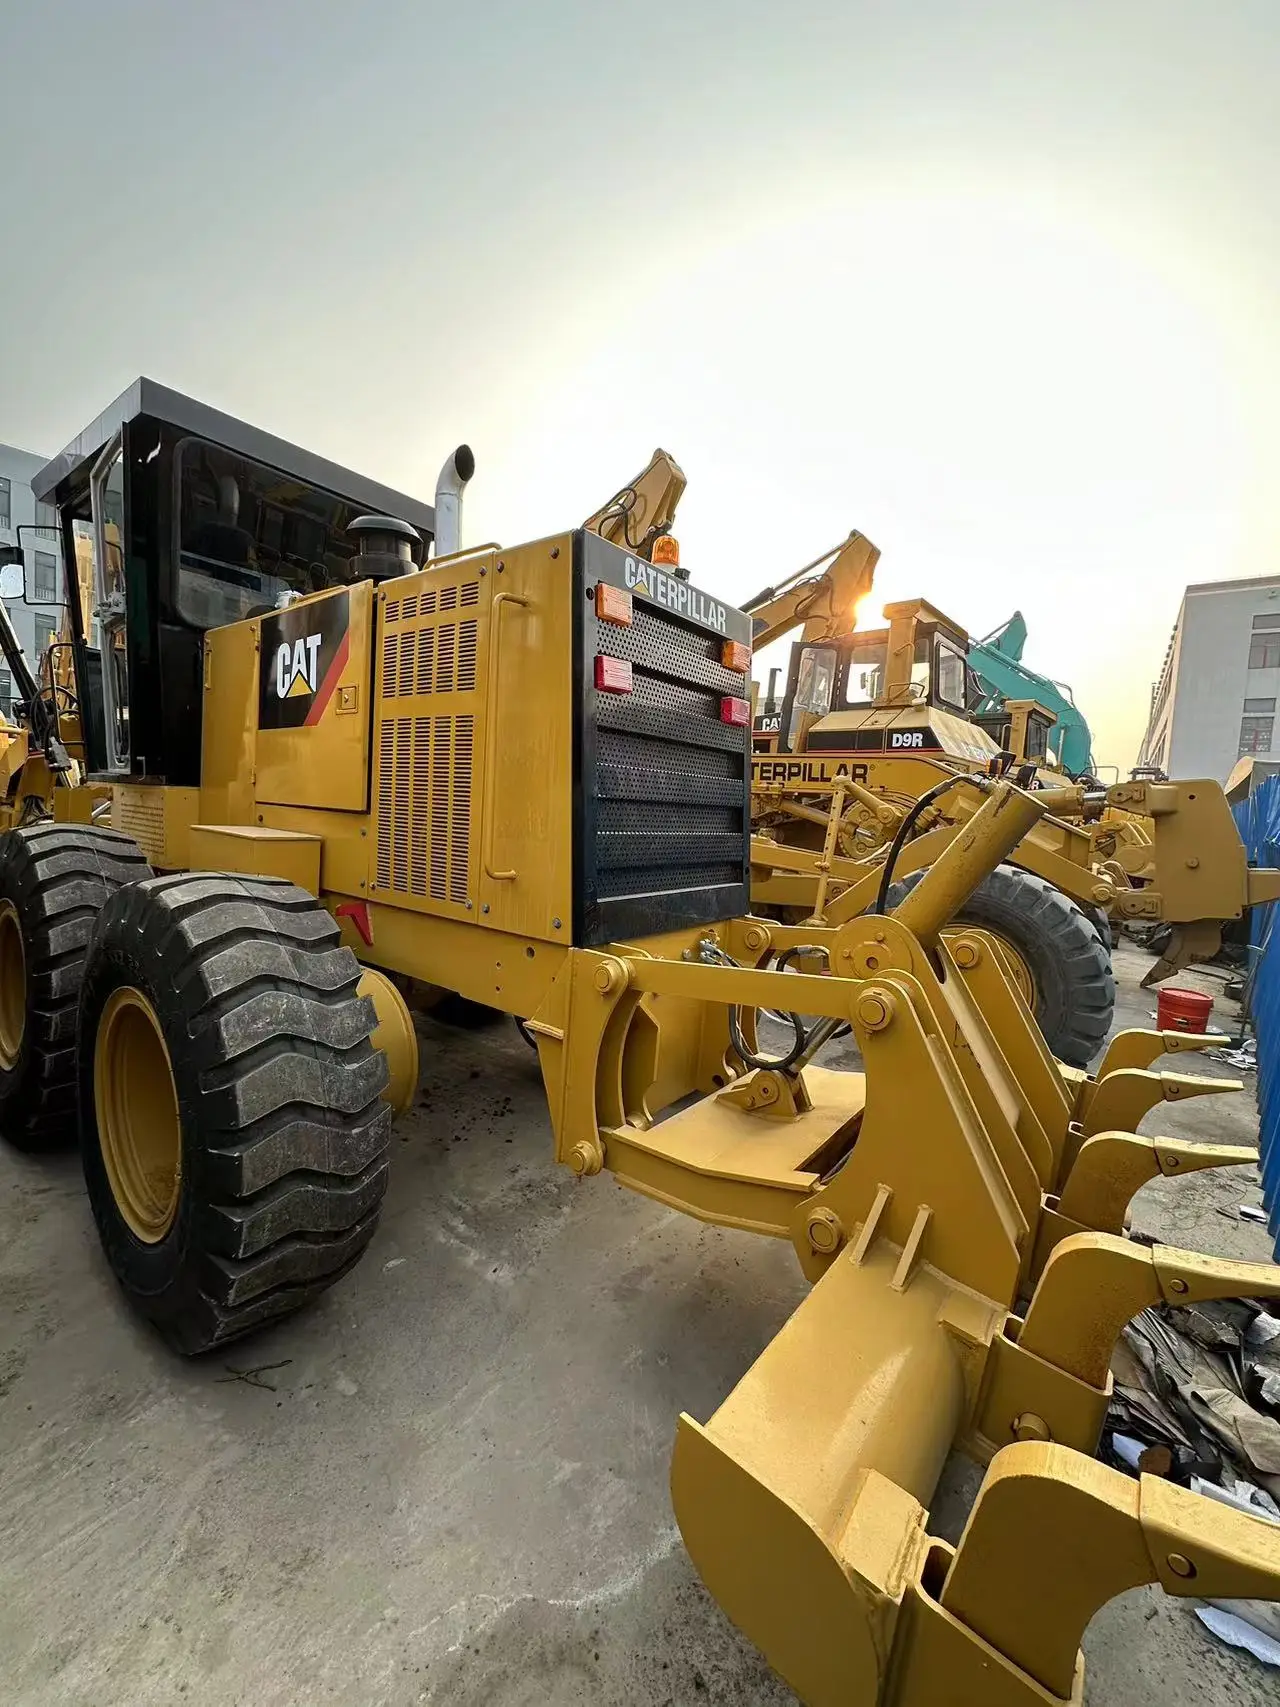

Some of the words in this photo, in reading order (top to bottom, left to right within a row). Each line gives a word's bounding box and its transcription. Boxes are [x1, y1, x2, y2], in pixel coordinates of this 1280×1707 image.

[625, 557, 726, 633] CATERPILLAR
[277, 633, 322, 699] CAT
[762, 717, 781, 731] CA
[892, 733, 924, 748] D9R
